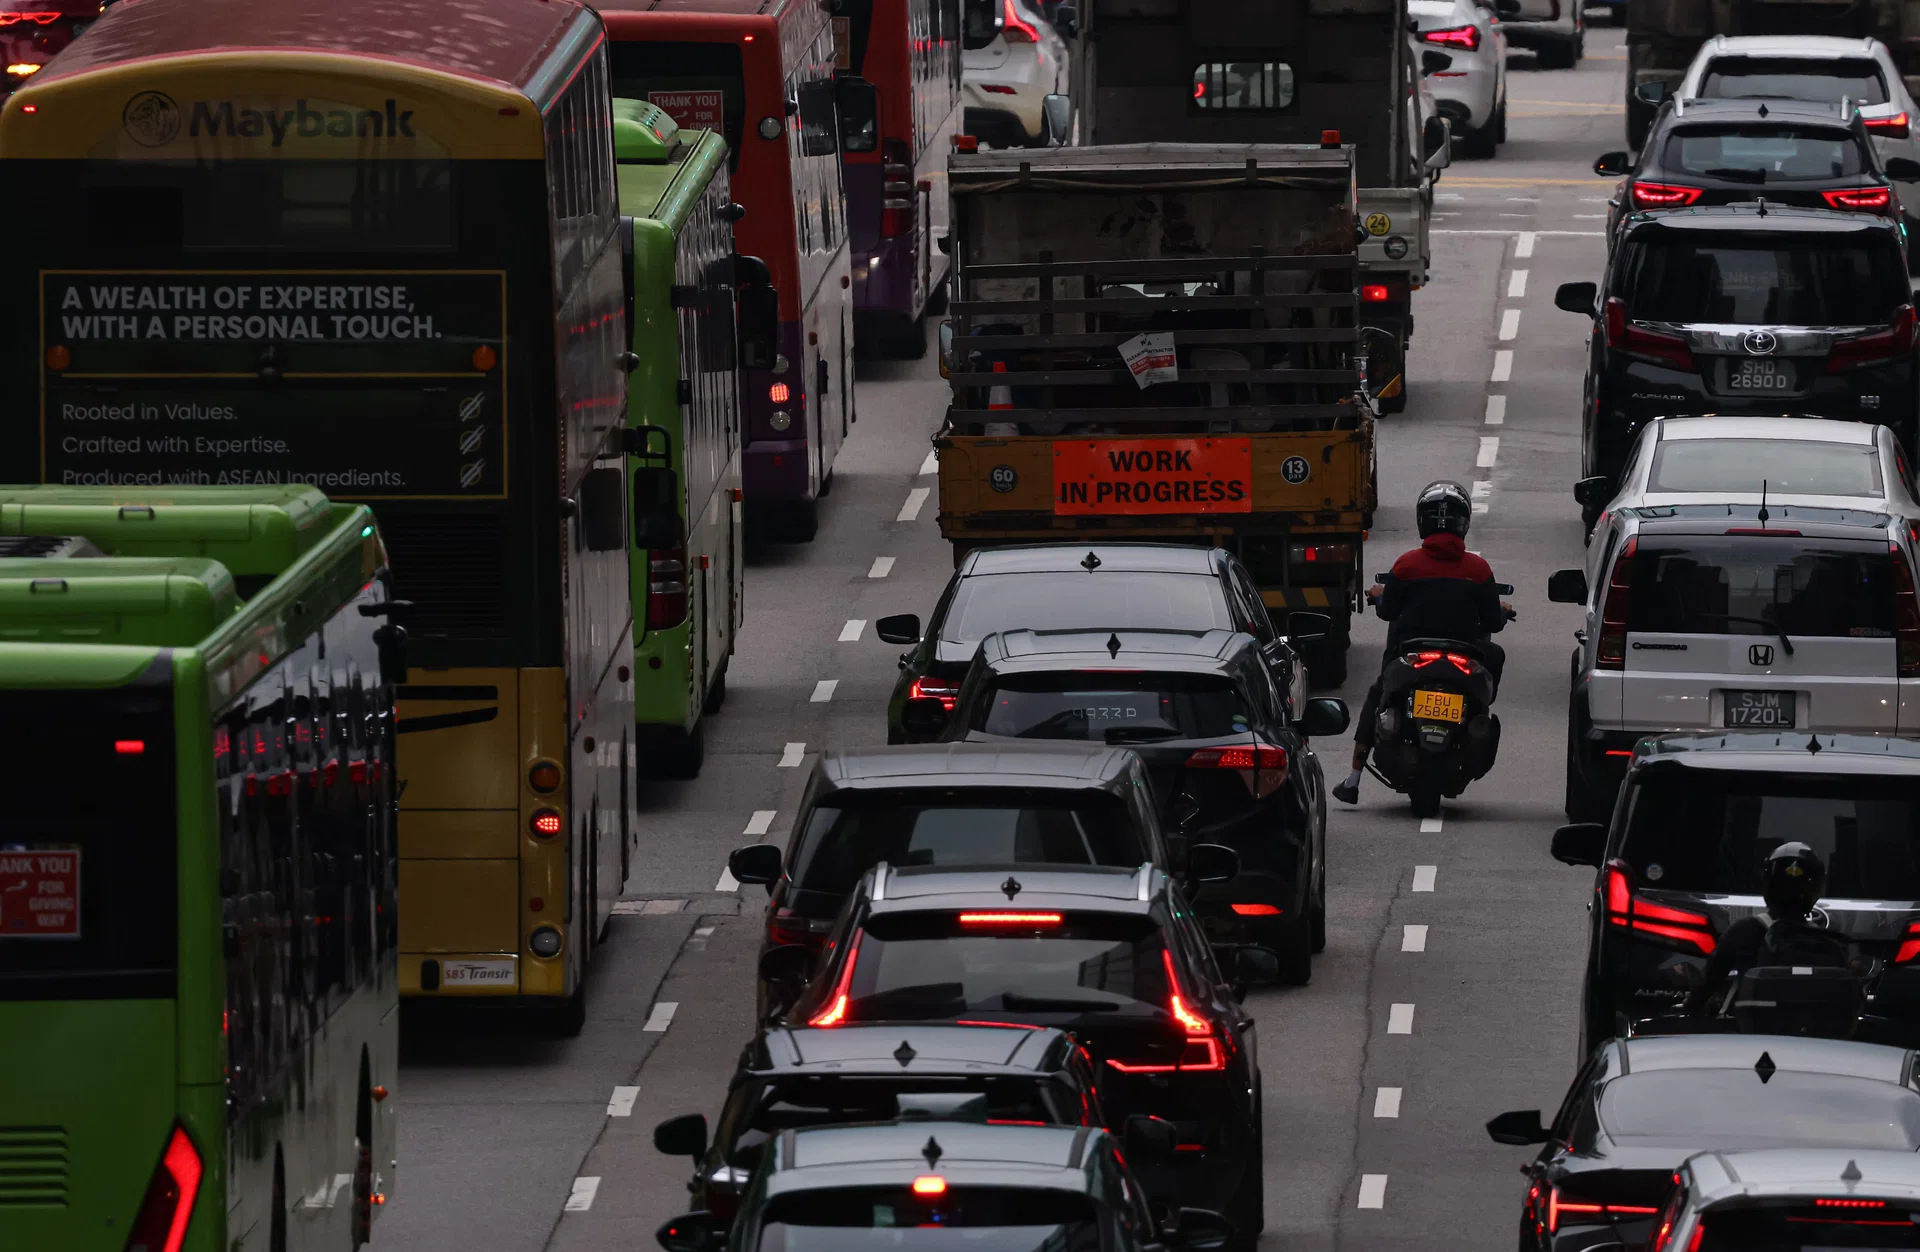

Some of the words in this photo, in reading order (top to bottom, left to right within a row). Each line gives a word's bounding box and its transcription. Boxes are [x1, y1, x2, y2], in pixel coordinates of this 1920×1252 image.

[654, 96, 691, 107] THANK
[695, 95, 717, 106] YOU
[695, 111, 713, 120] FOR
[190, 99, 416, 147] Maybank
[1370, 215, 1386, 228] 24
[61, 286, 83, 309] A
[89, 286, 206, 309] WEALTH
[213, 286, 252, 309] OF
[260, 286, 415, 313] EXPERTISE,
[62, 315, 138, 339] WITH
[145, 315, 167, 339] A
[174, 315, 324, 339] PERSONAL
[331, 315, 442, 339] TOUCH.
[1743, 360, 1775, 375] SHD
[1731, 374, 1787, 388] 2690D
[1631, 391, 1686, 401] ALPHARD
[62, 403, 135, 420] Rooted
[141, 403, 158, 420] in
[165, 403, 238, 420] Values.
[62, 436, 141, 453] Crafted
[146, 436, 189, 453] with
[195, 436, 290, 458] Expertise.
[1108, 450, 1193, 473] WORK
[1286, 460, 1304, 474] 13
[63, 469, 162, 485] Produced
[168, 469, 210, 485] with
[216, 470, 280, 485] ASEAN
[288, 468, 406, 487] Ingredients.
[993, 469, 1014, 482] 60
[1061, 482, 1087, 504] IN
[1096, 480, 1244, 503] PROGRESS
[1426, 694, 1451, 706] FBU
[1742, 692, 1779, 707] SJM
[1416, 705, 1459, 719] 7584B
[1731, 708, 1789, 724] 1720L
[0, 857, 34, 873] ANK
[38, 857, 71, 873] YOU
[38, 881, 65, 895] FOR
[29, 897, 74, 911] GIVING
[36, 913, 67, 926] WAY
[445, 969, 465, 979] SBS
[464, 966, 512, 980] Transit
